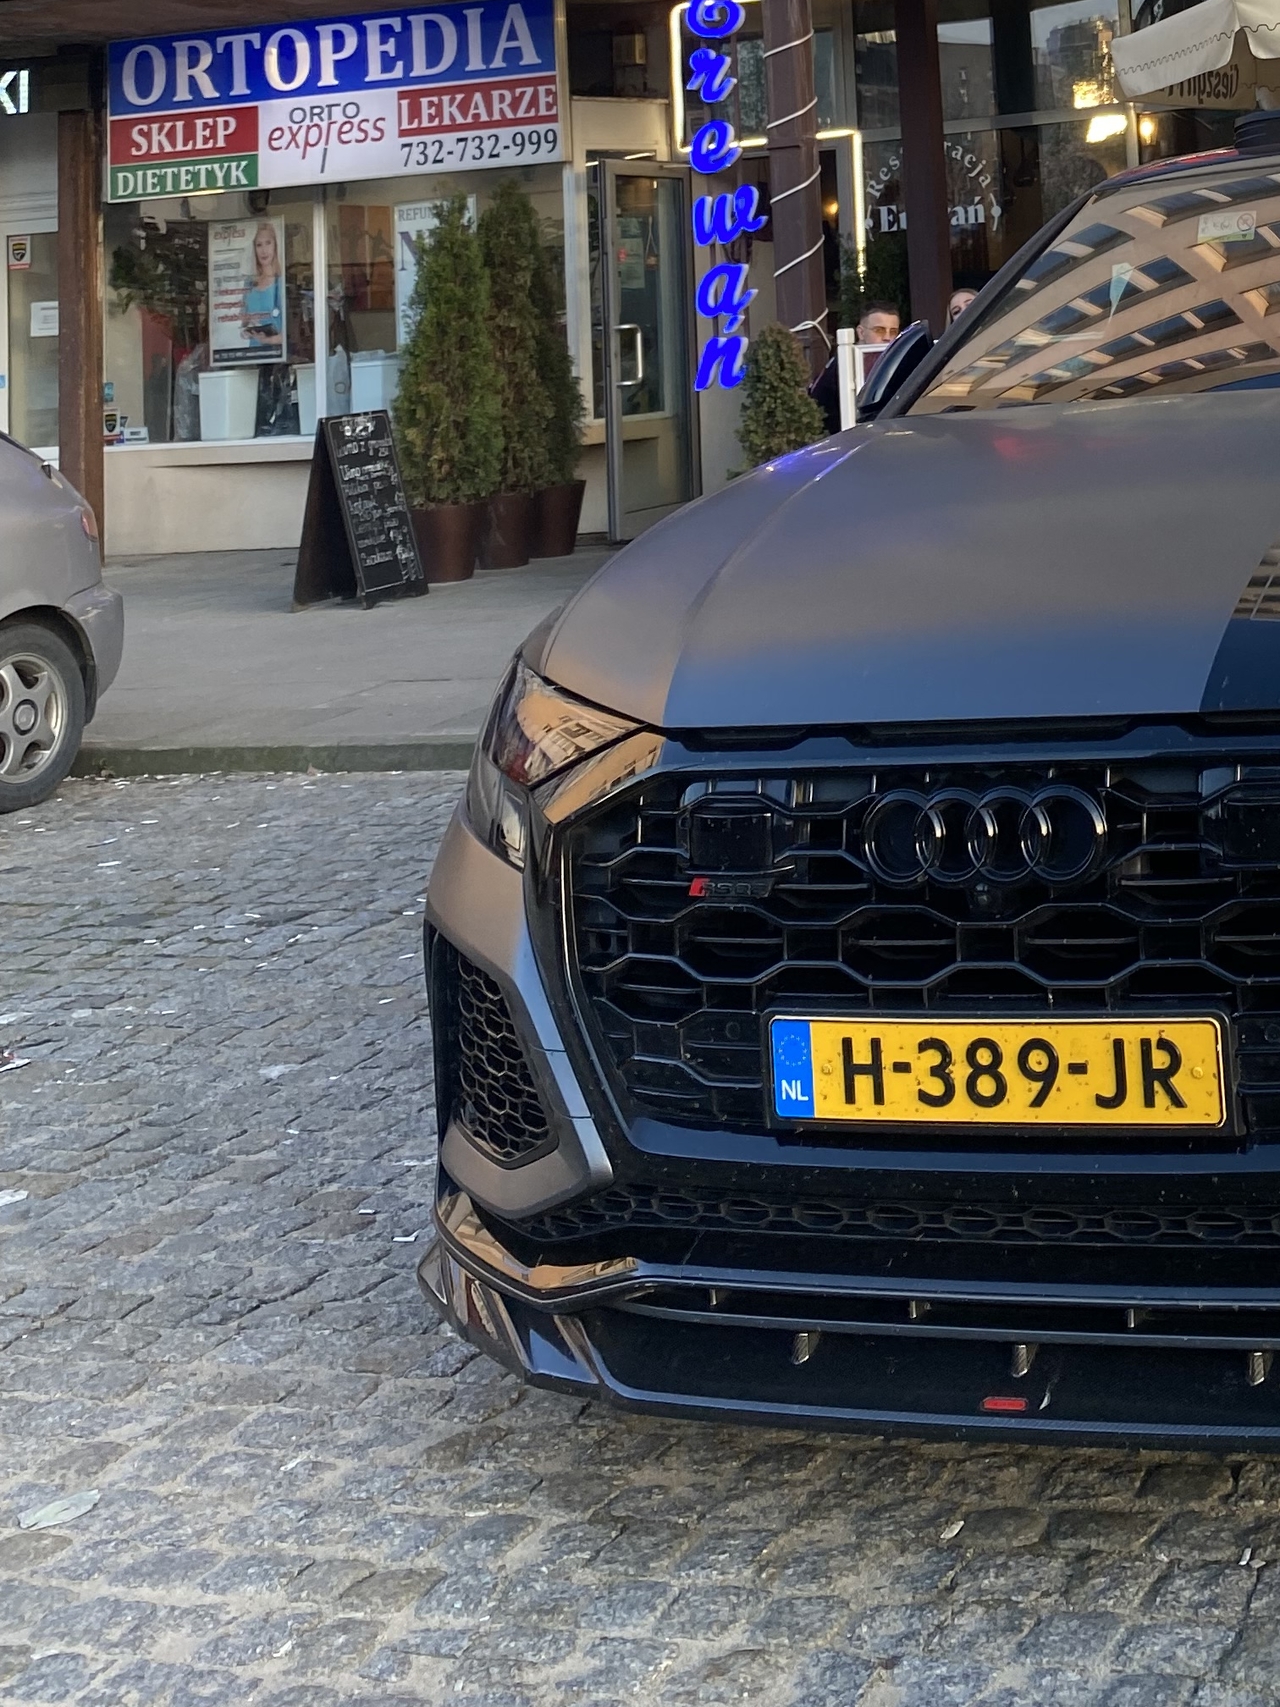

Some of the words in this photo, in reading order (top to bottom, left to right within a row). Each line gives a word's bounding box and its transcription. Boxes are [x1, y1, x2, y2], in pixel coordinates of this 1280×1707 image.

[122, 3, 542, 106] ORTOPEDIA
[289, 102, 361, 125] ORTO
[399, 84, 557, 131] LEKARZE
[131, 116, 237, 157] SKLEP
[268, 116, 386, 160] express
[401, 128, 558, 167] 732-732-999
[117, 161, 249, 196] DIETETYK
[781, 1079, 809, 1102] NL
[841, 1037, 1188, 1109] H-389-JR
